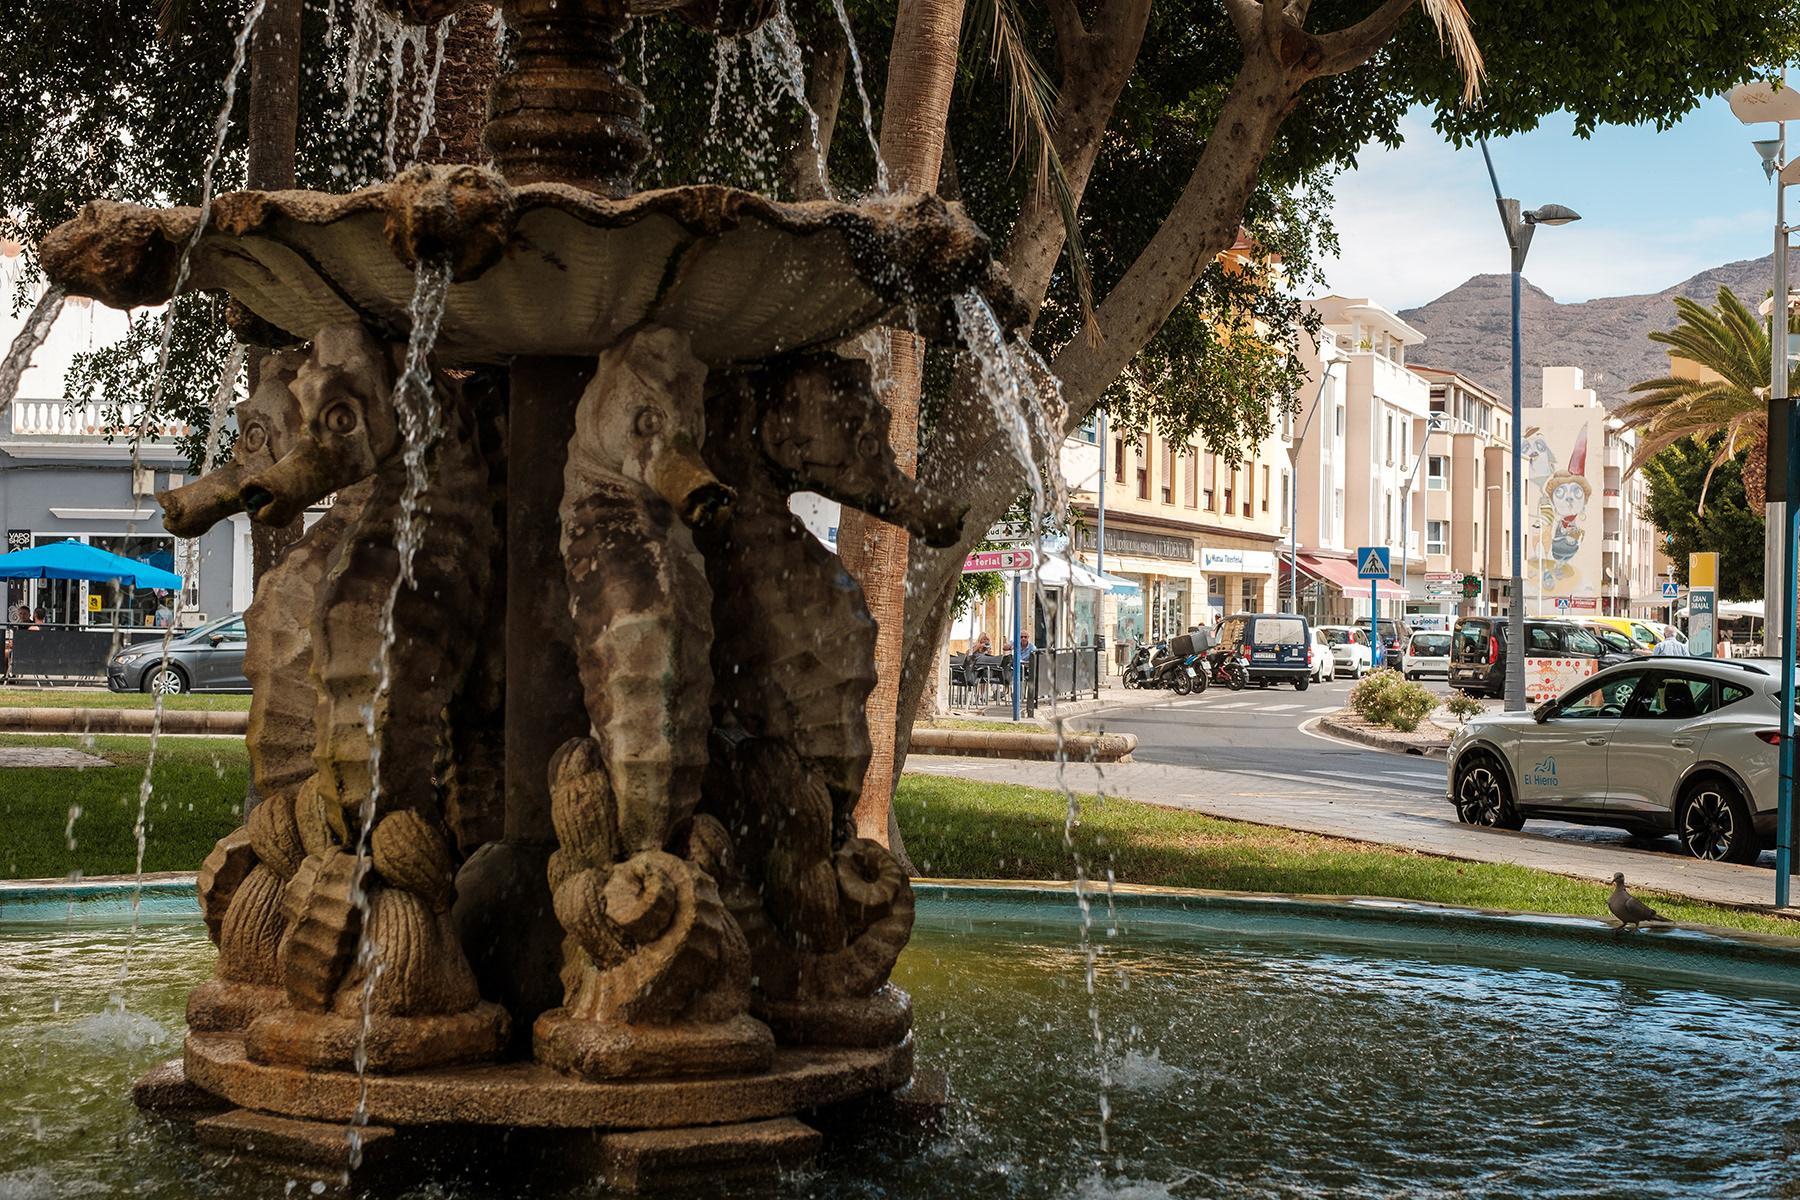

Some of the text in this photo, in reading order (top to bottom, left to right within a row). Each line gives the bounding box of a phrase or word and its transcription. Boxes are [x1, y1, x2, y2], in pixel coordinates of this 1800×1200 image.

[975, 557, 1000, 566] ferial
[1524, 774, 1558, 786] El Hierro
